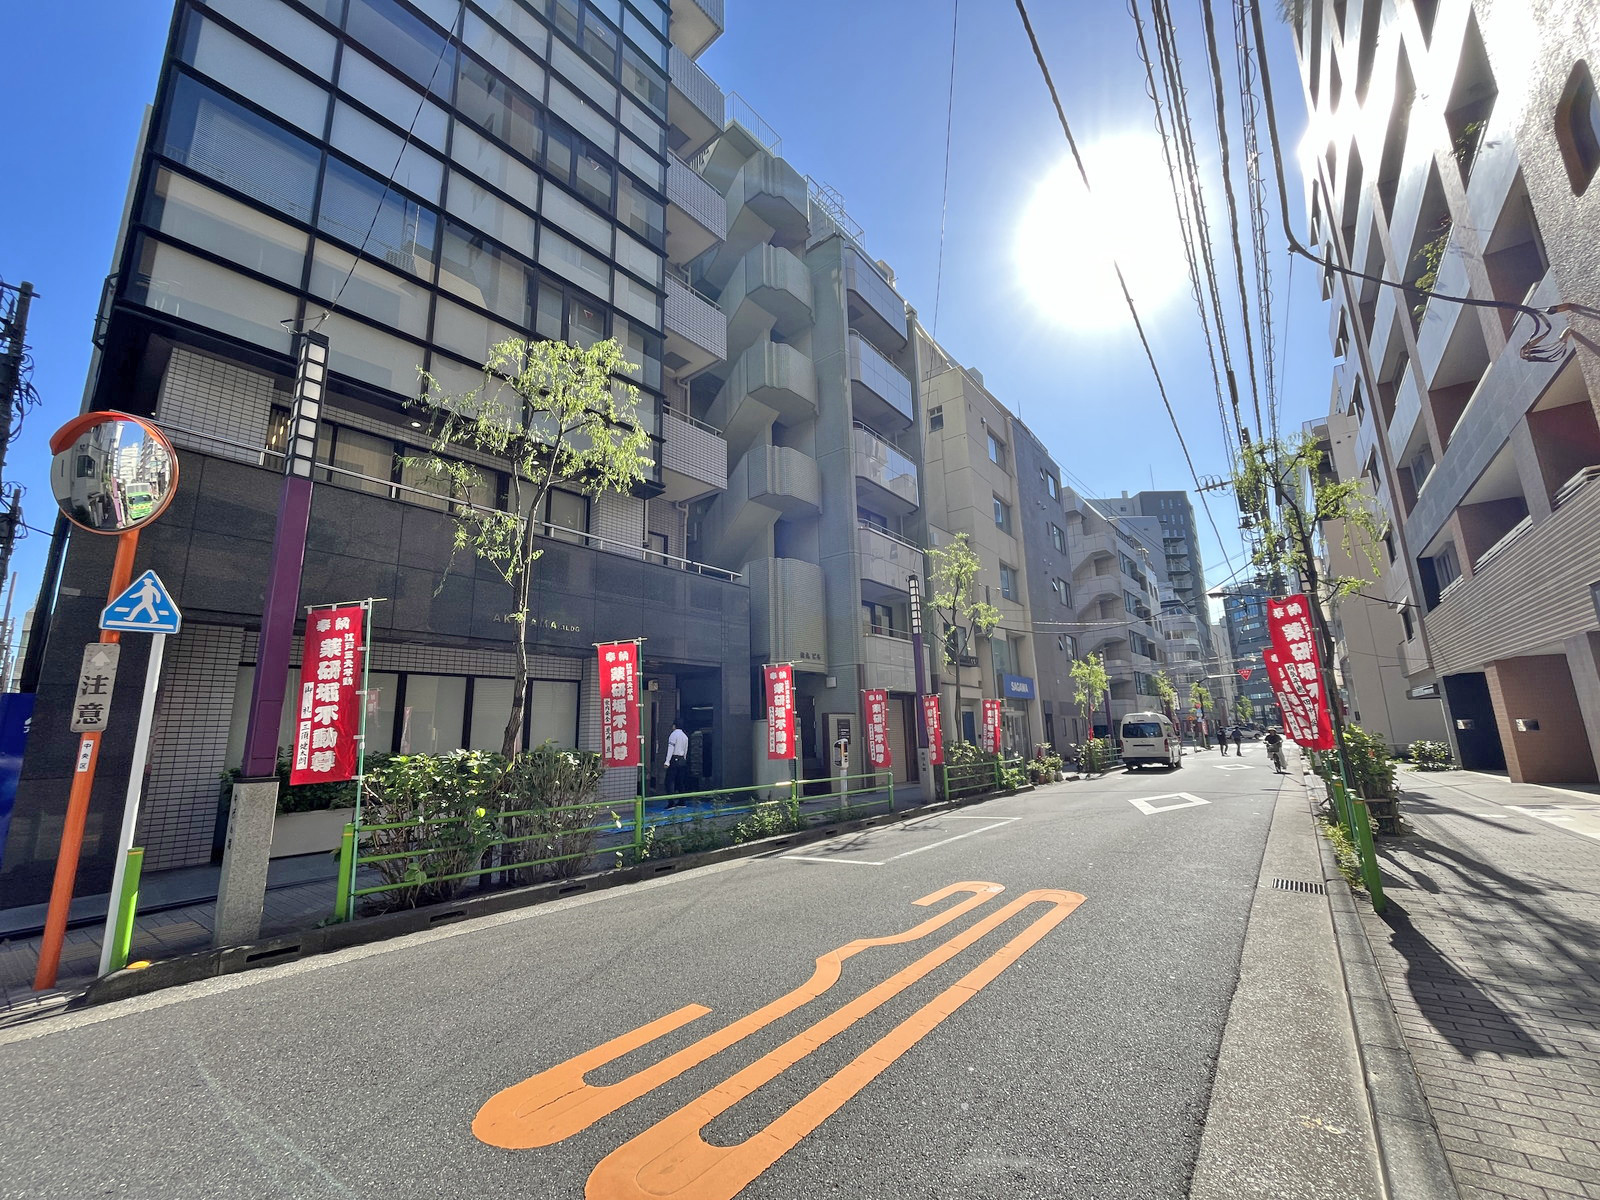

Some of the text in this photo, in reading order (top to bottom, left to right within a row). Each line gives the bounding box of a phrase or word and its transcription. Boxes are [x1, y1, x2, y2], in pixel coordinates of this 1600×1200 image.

[316, 617, 351, 632] 奉納
[1272, 602, 1303, 619] 奉納
[343, 633, 355, 686] 江戸三大不動
[605, 651, 629, 662] 奉納
[76, 675, 109, 725] 注意
[310, 637, 343, 773] 薬研堀不動尊
[610, 666, 628, 760] 薬研堀不動尊
[79, 743, 92, 769] 中央区
[471, 880, 1087, 1200] 30
